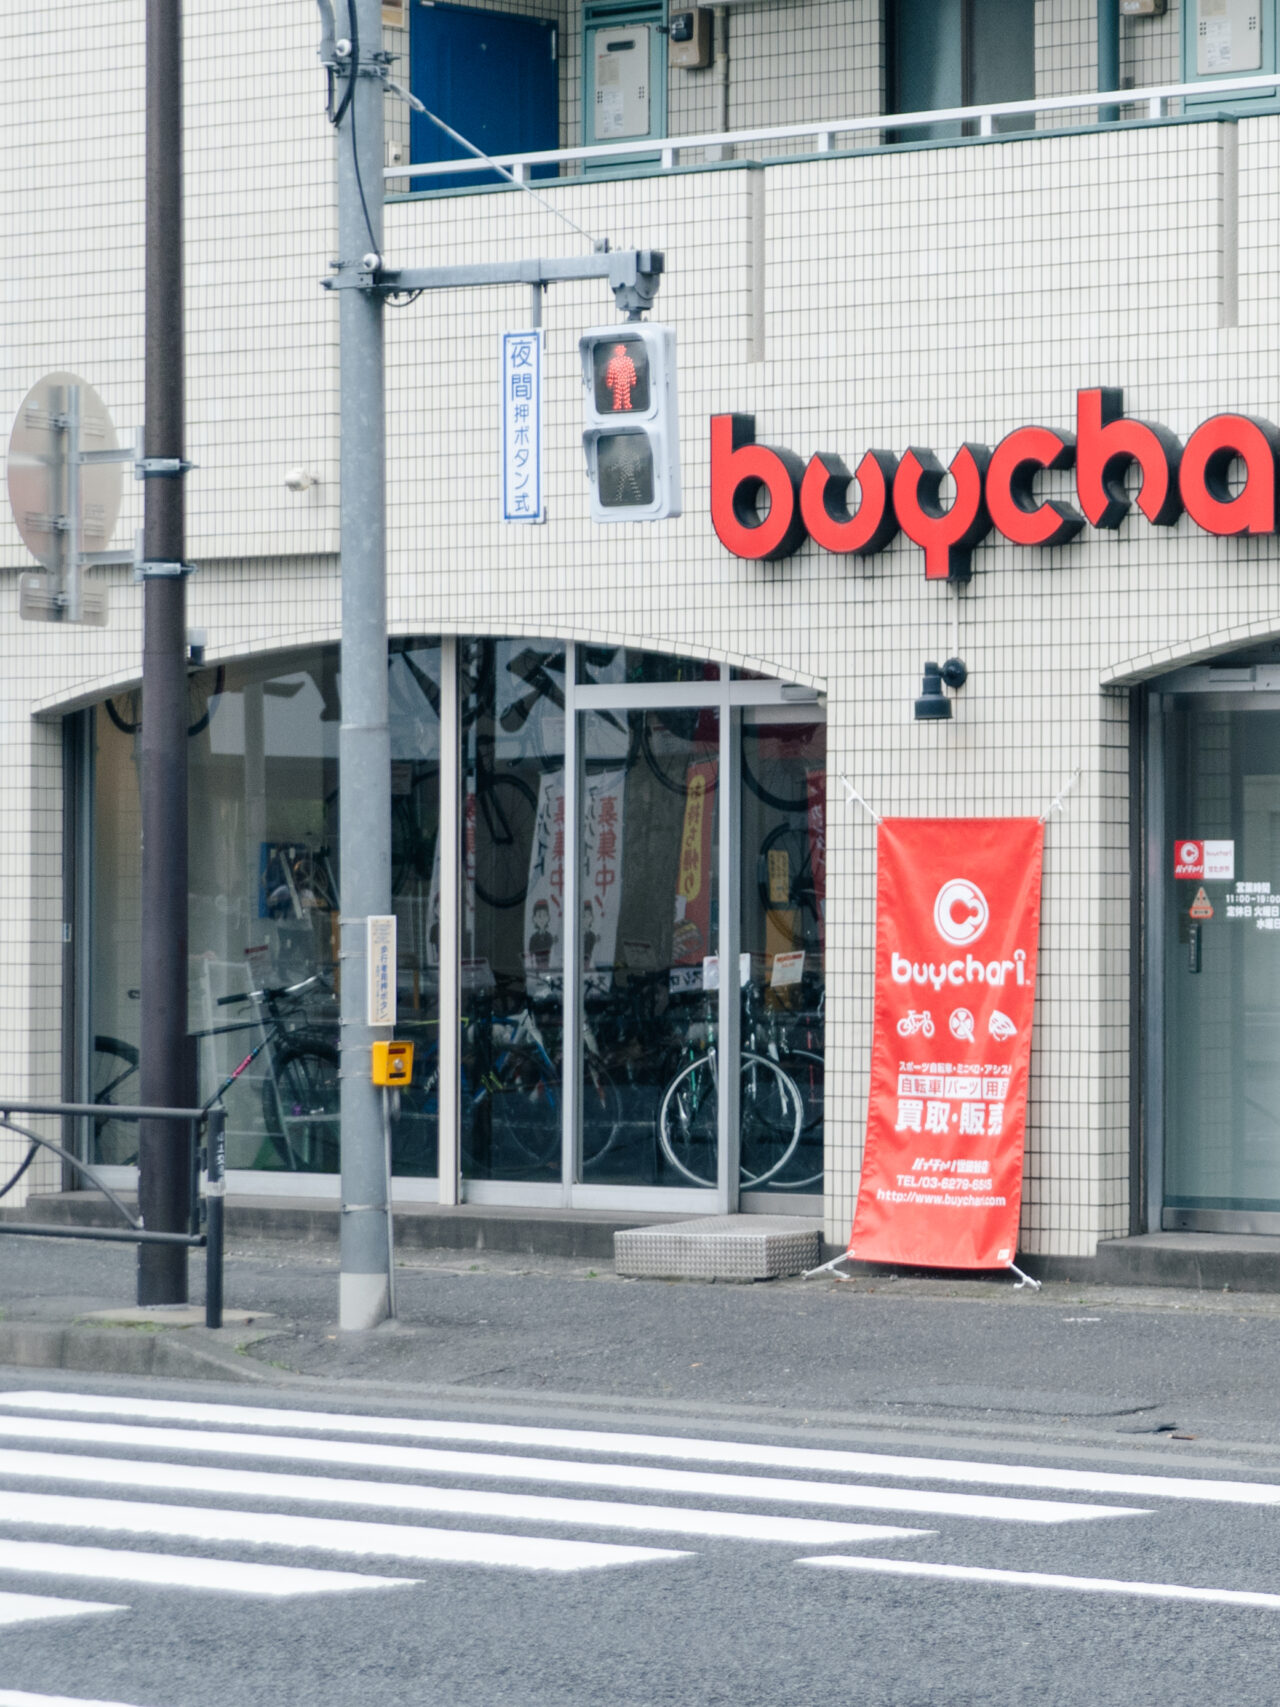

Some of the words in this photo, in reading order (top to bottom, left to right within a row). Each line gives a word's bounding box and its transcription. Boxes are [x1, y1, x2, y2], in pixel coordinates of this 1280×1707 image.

[510, 340, 533, 512] 夜間押ボタン式
[891, 949, 1028, 991] buychari
